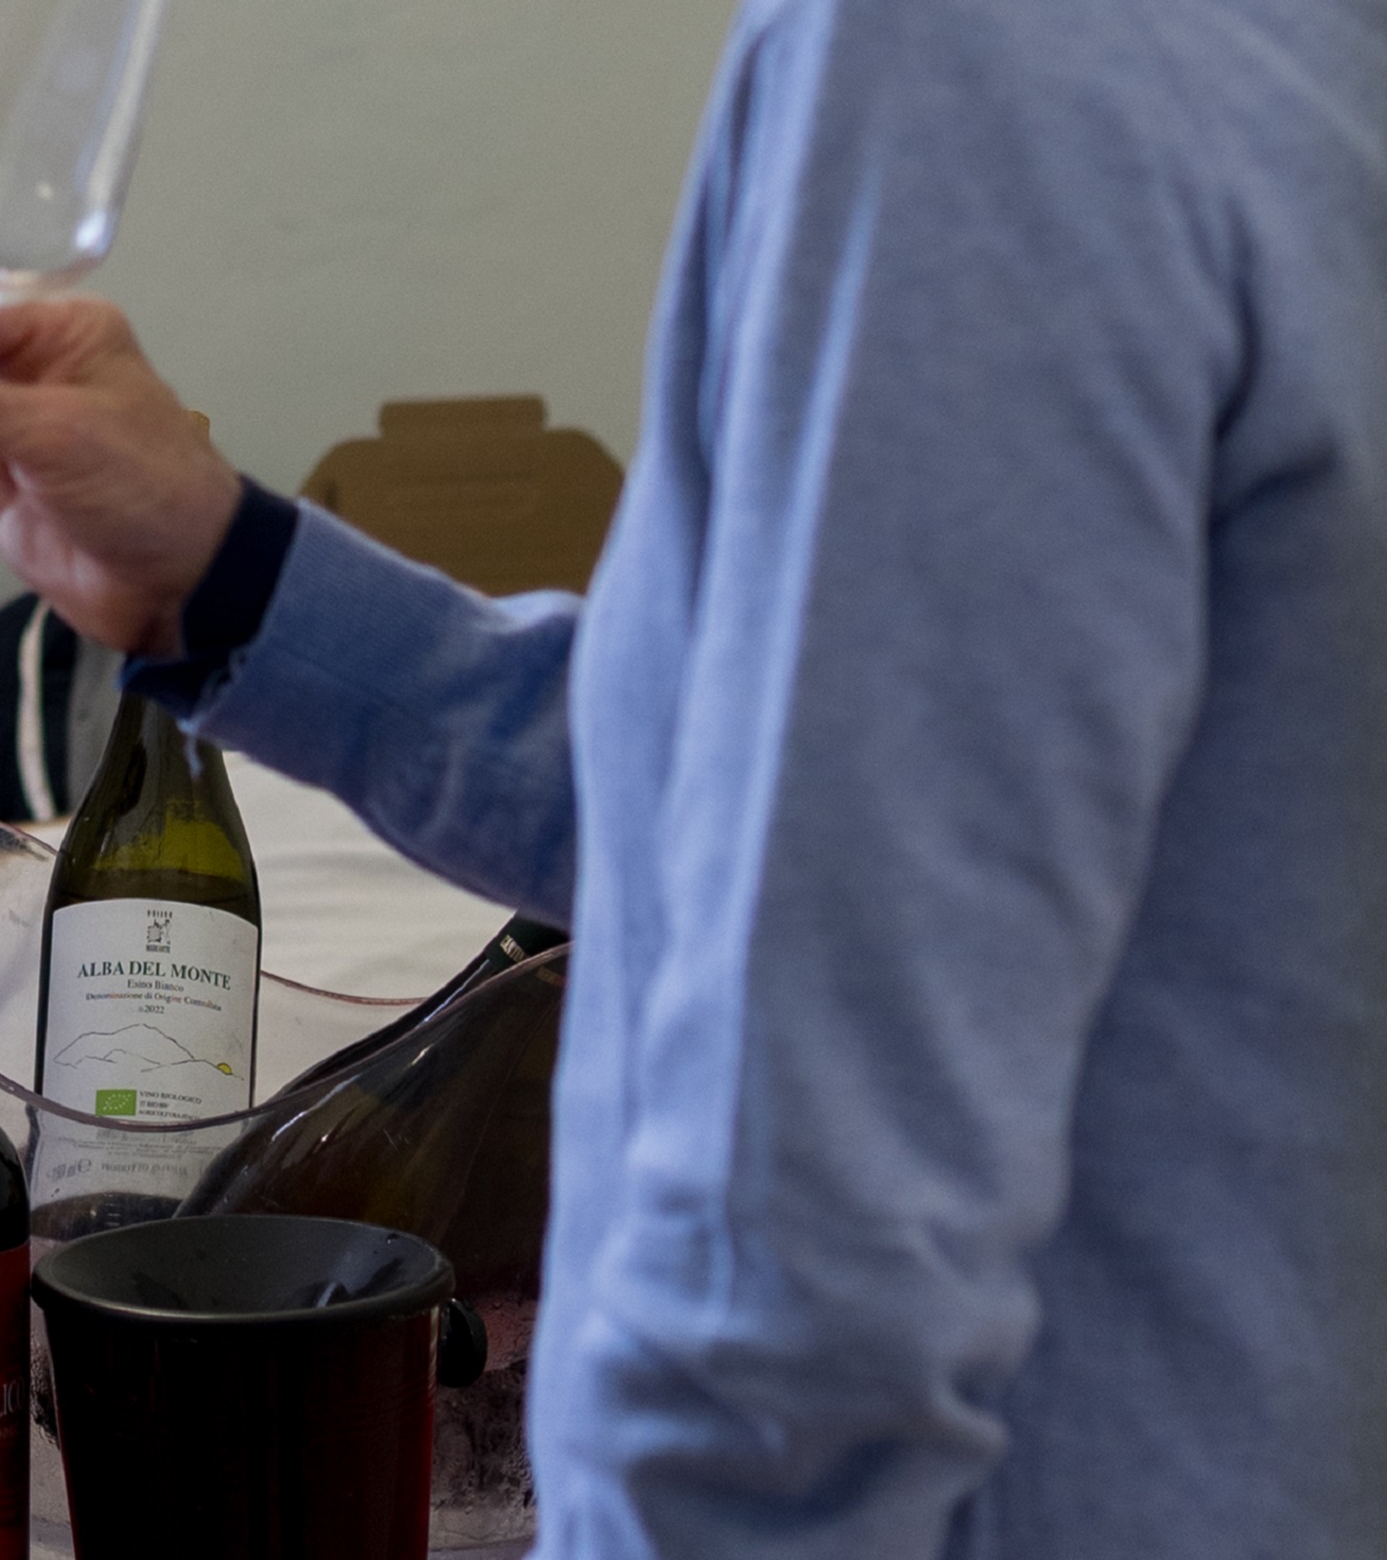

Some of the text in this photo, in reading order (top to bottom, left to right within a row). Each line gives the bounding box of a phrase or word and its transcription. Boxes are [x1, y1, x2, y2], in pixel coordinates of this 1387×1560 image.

[77, 960, 232, 991] ALBA DEL MONTE
[127, 979, 184, 993] Esino Bianco
